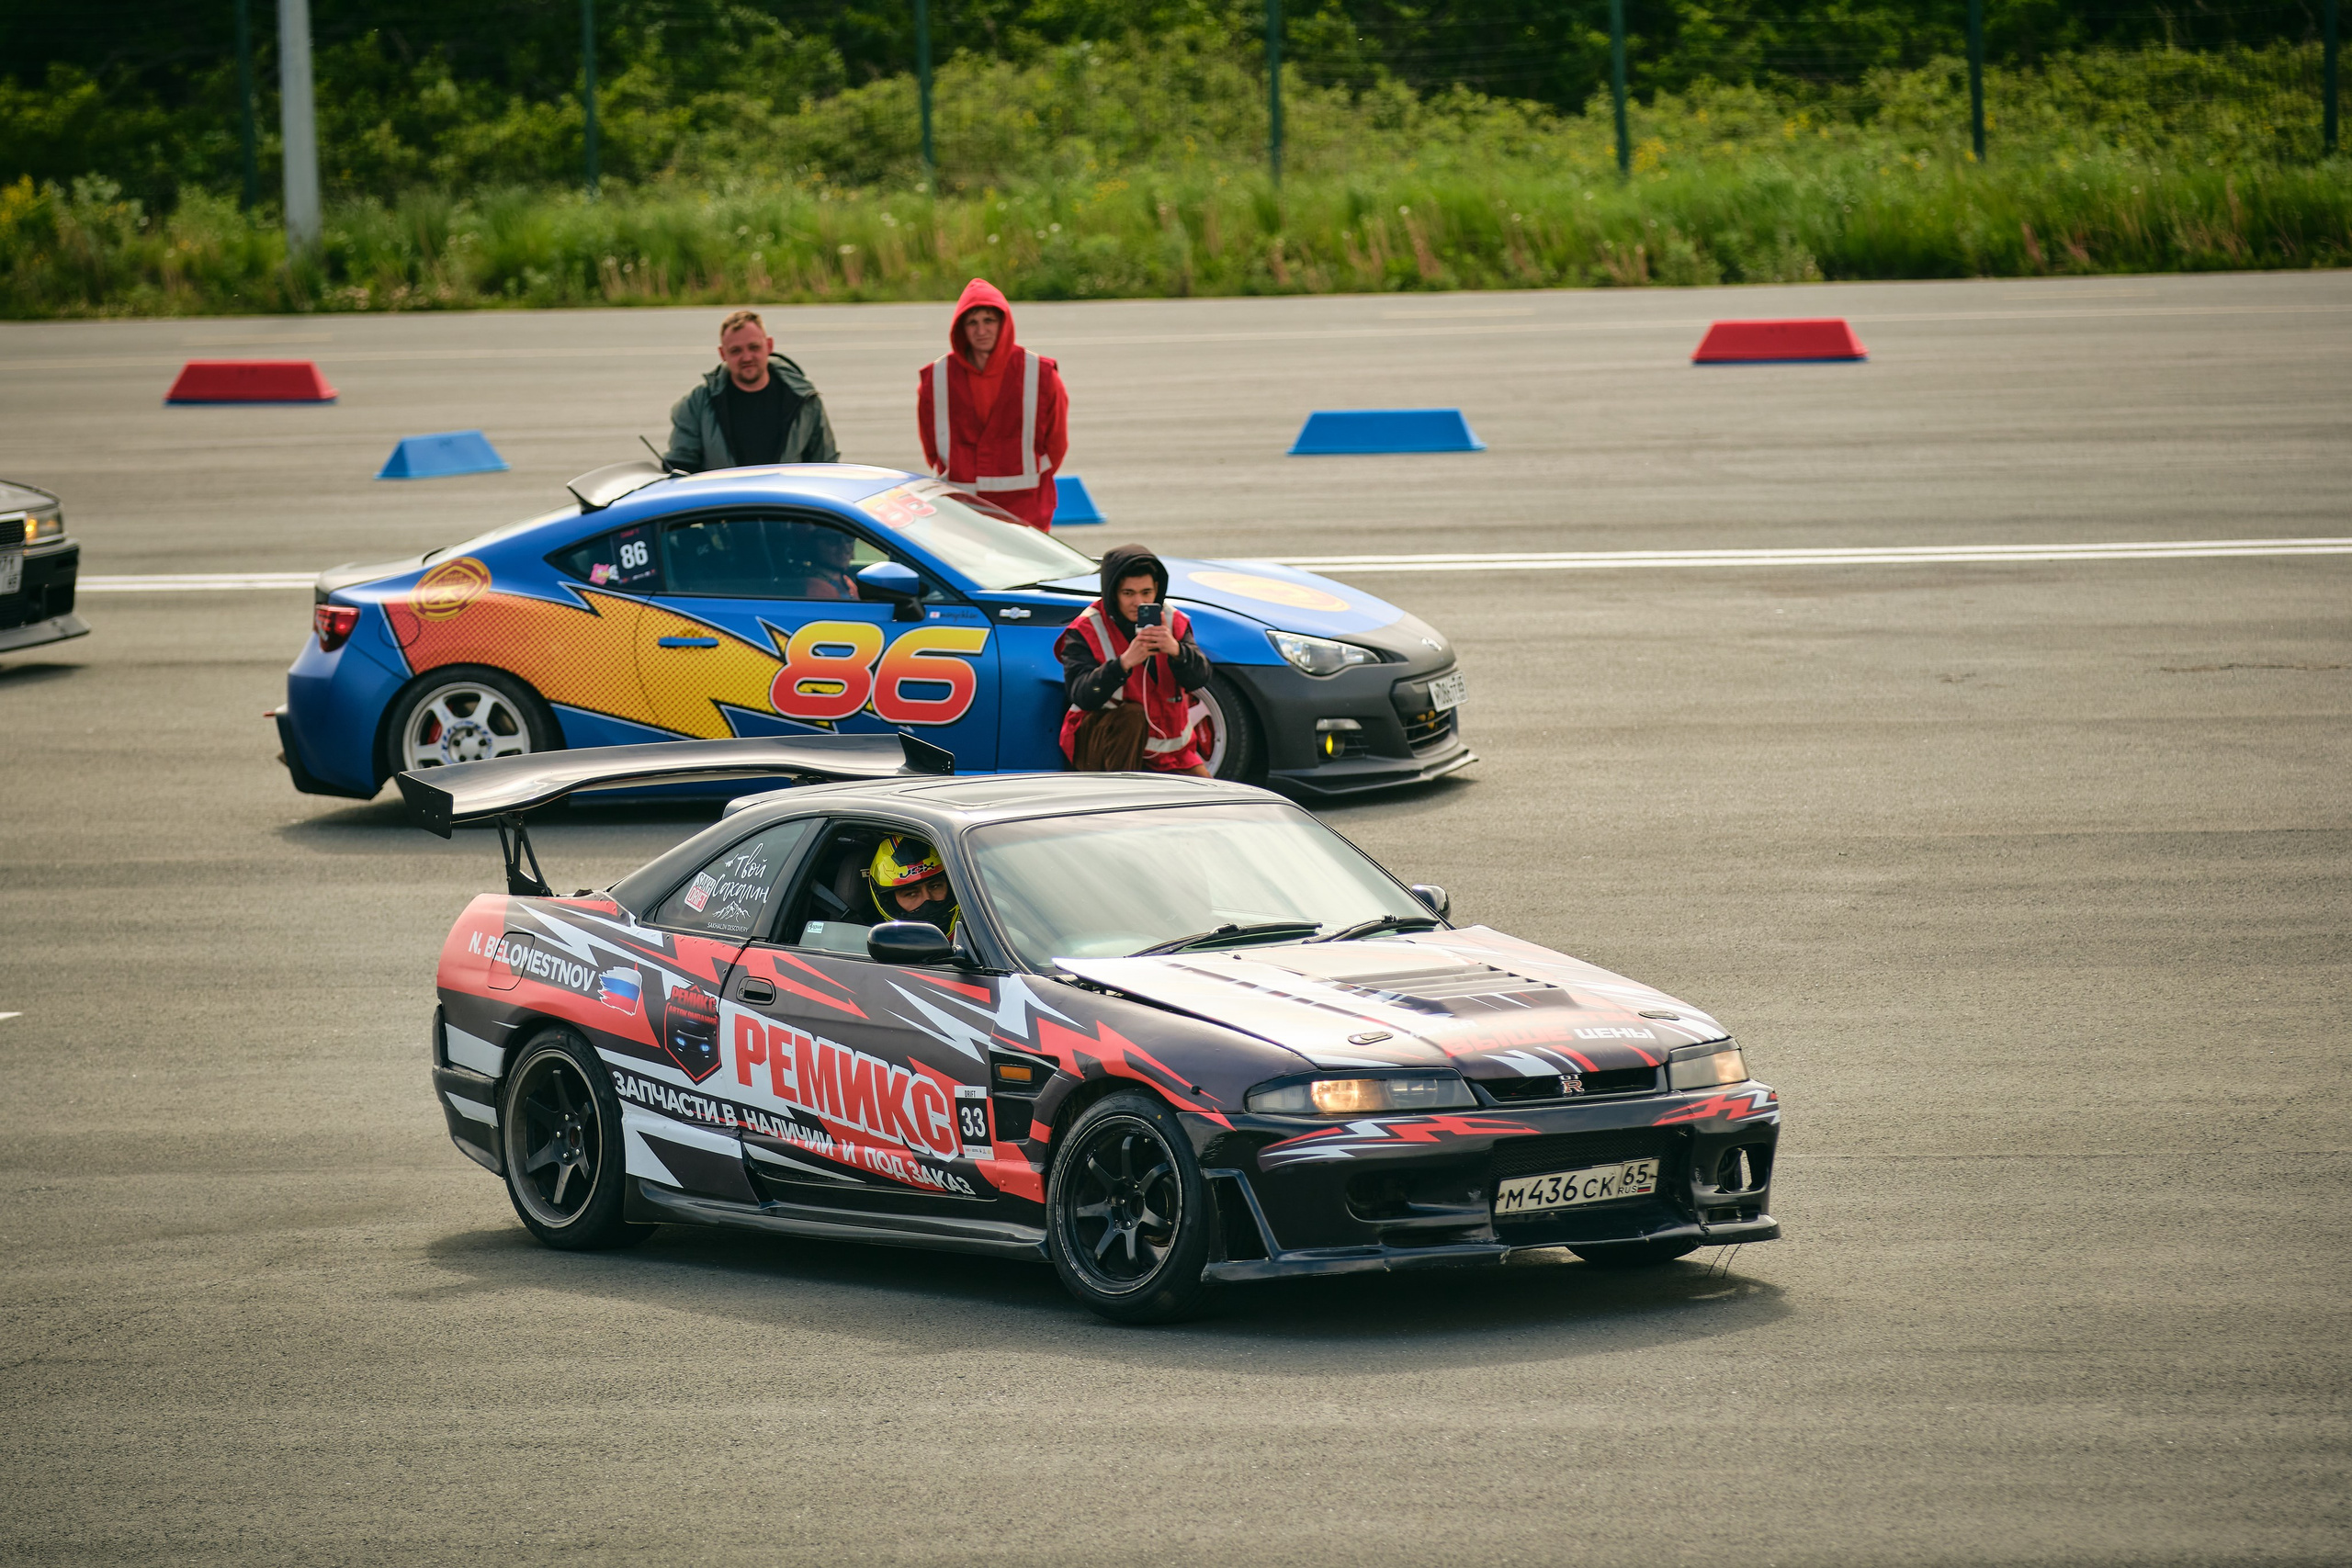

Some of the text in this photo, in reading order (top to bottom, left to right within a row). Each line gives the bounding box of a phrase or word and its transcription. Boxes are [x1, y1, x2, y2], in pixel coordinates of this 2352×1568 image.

[619, 540, 649, 570] 86
[769, 619, 991, 727] 86
[734, 842, 768, 879] Твой
[687, 887, 708, 909] DRIFT
[695, 874, 717, 894] SAKH
[712, 874, 770, 904] Сахалин
[727, 924, 749, 932] DISCOVERY
[468, 931, 596, 992] N. BELOMESTNOV
[671, 986, 717, 1014] РЕМИКС
[1440, 1026, 1574, 1056] ВЫШЕ
[1574, 1027, 1656, 1040] ЦЕНЫ
[733, 1011, 957, 1158] РЕМИКС
[965, 1089, 976, 1098] DRIFT
[1561, 1079, 1585, 1094] R
[612, 1070, 976, 1195] ЗАПЧАСТИ В НАЛИЧИИ И ПОД ЗАКАЗ
[961, 1106, 986, 1137] 33
[1618, 1185, 1637, 1194] RUS
[1623, 1163, 1649, 1186] 65
